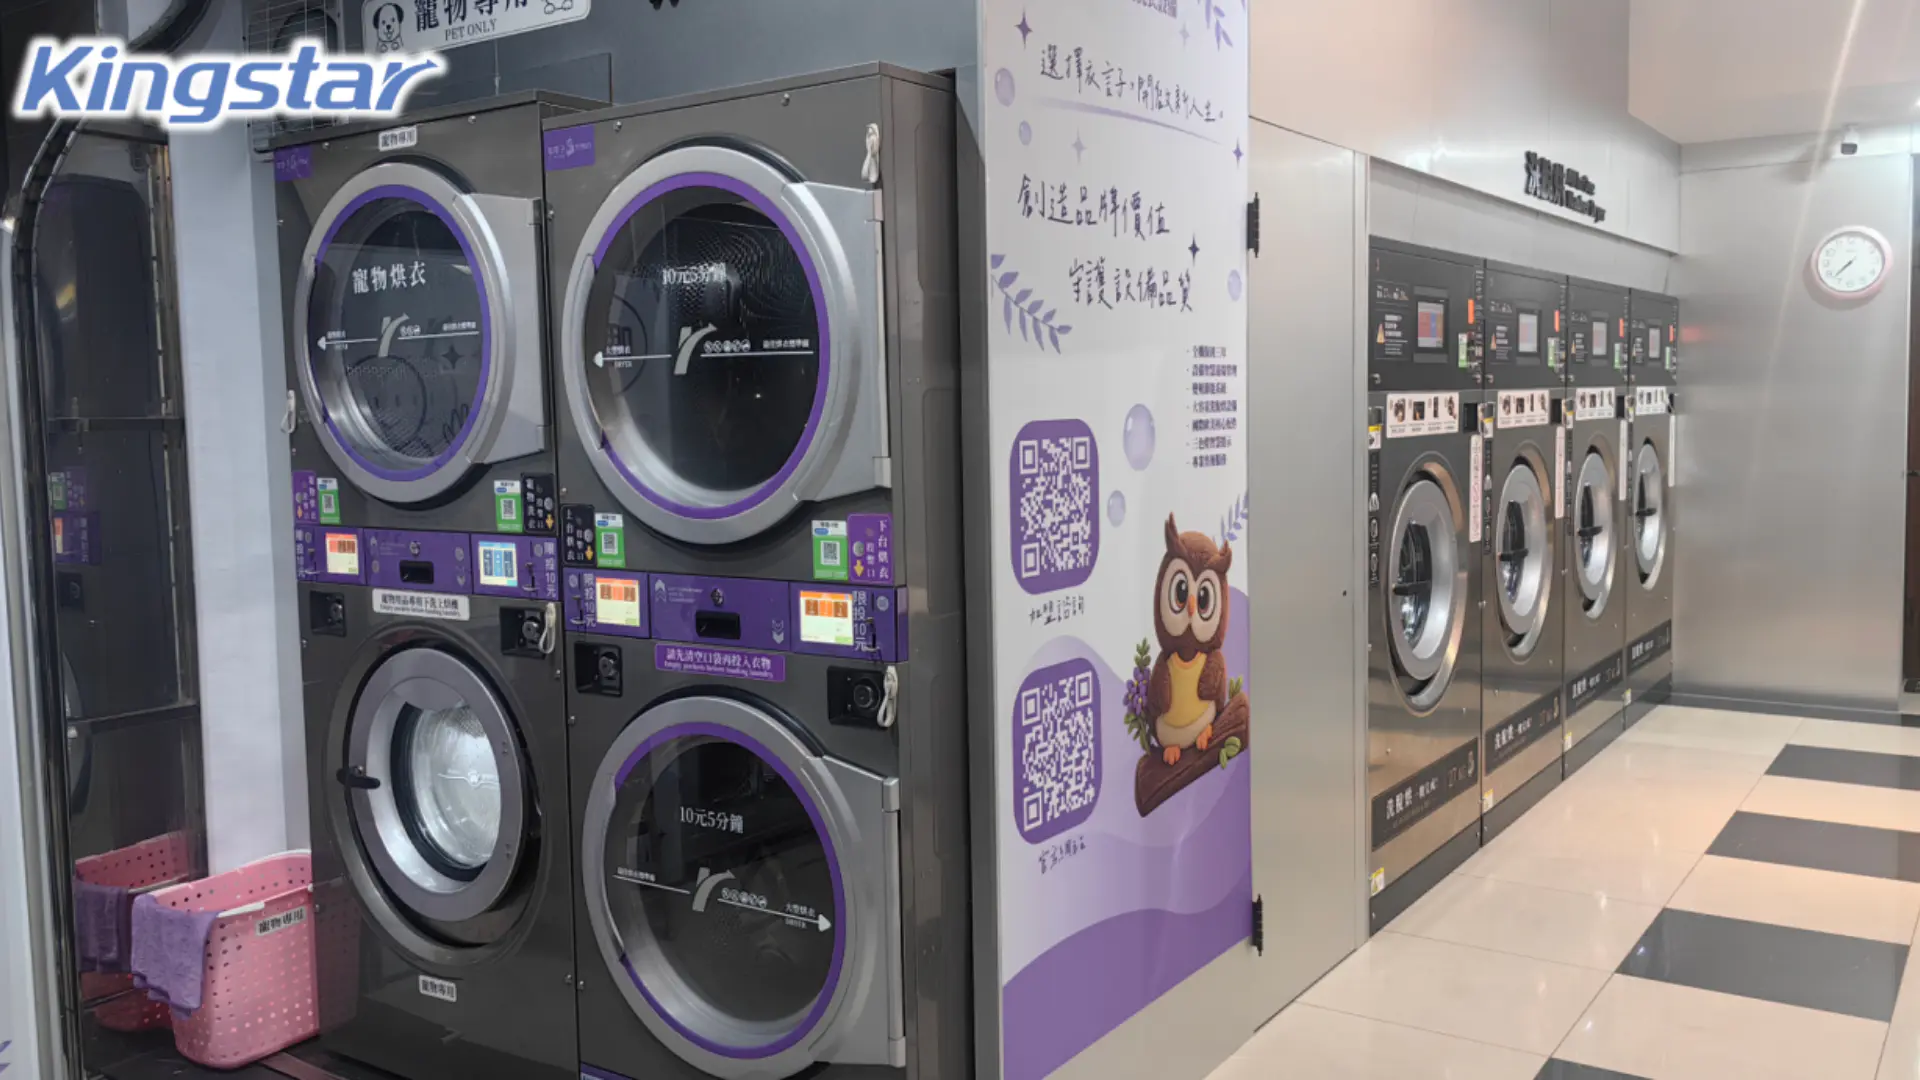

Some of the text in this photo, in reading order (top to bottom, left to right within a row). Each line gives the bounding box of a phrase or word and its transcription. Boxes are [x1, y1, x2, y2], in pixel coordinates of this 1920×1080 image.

[444, 18, 498, 42] PET ONLY
[1017, 173, 1171, 242] 創造品牌價值
[352, 260, 427, 295] 寵物烘衣
[1068, 255, 1194, 313] 守護設備品質
[582, 572, 597, 628] 限投10元
[679, 805, 745, 835] 10元5分鐘
[258, 907, 305, 935] 寵物專用
